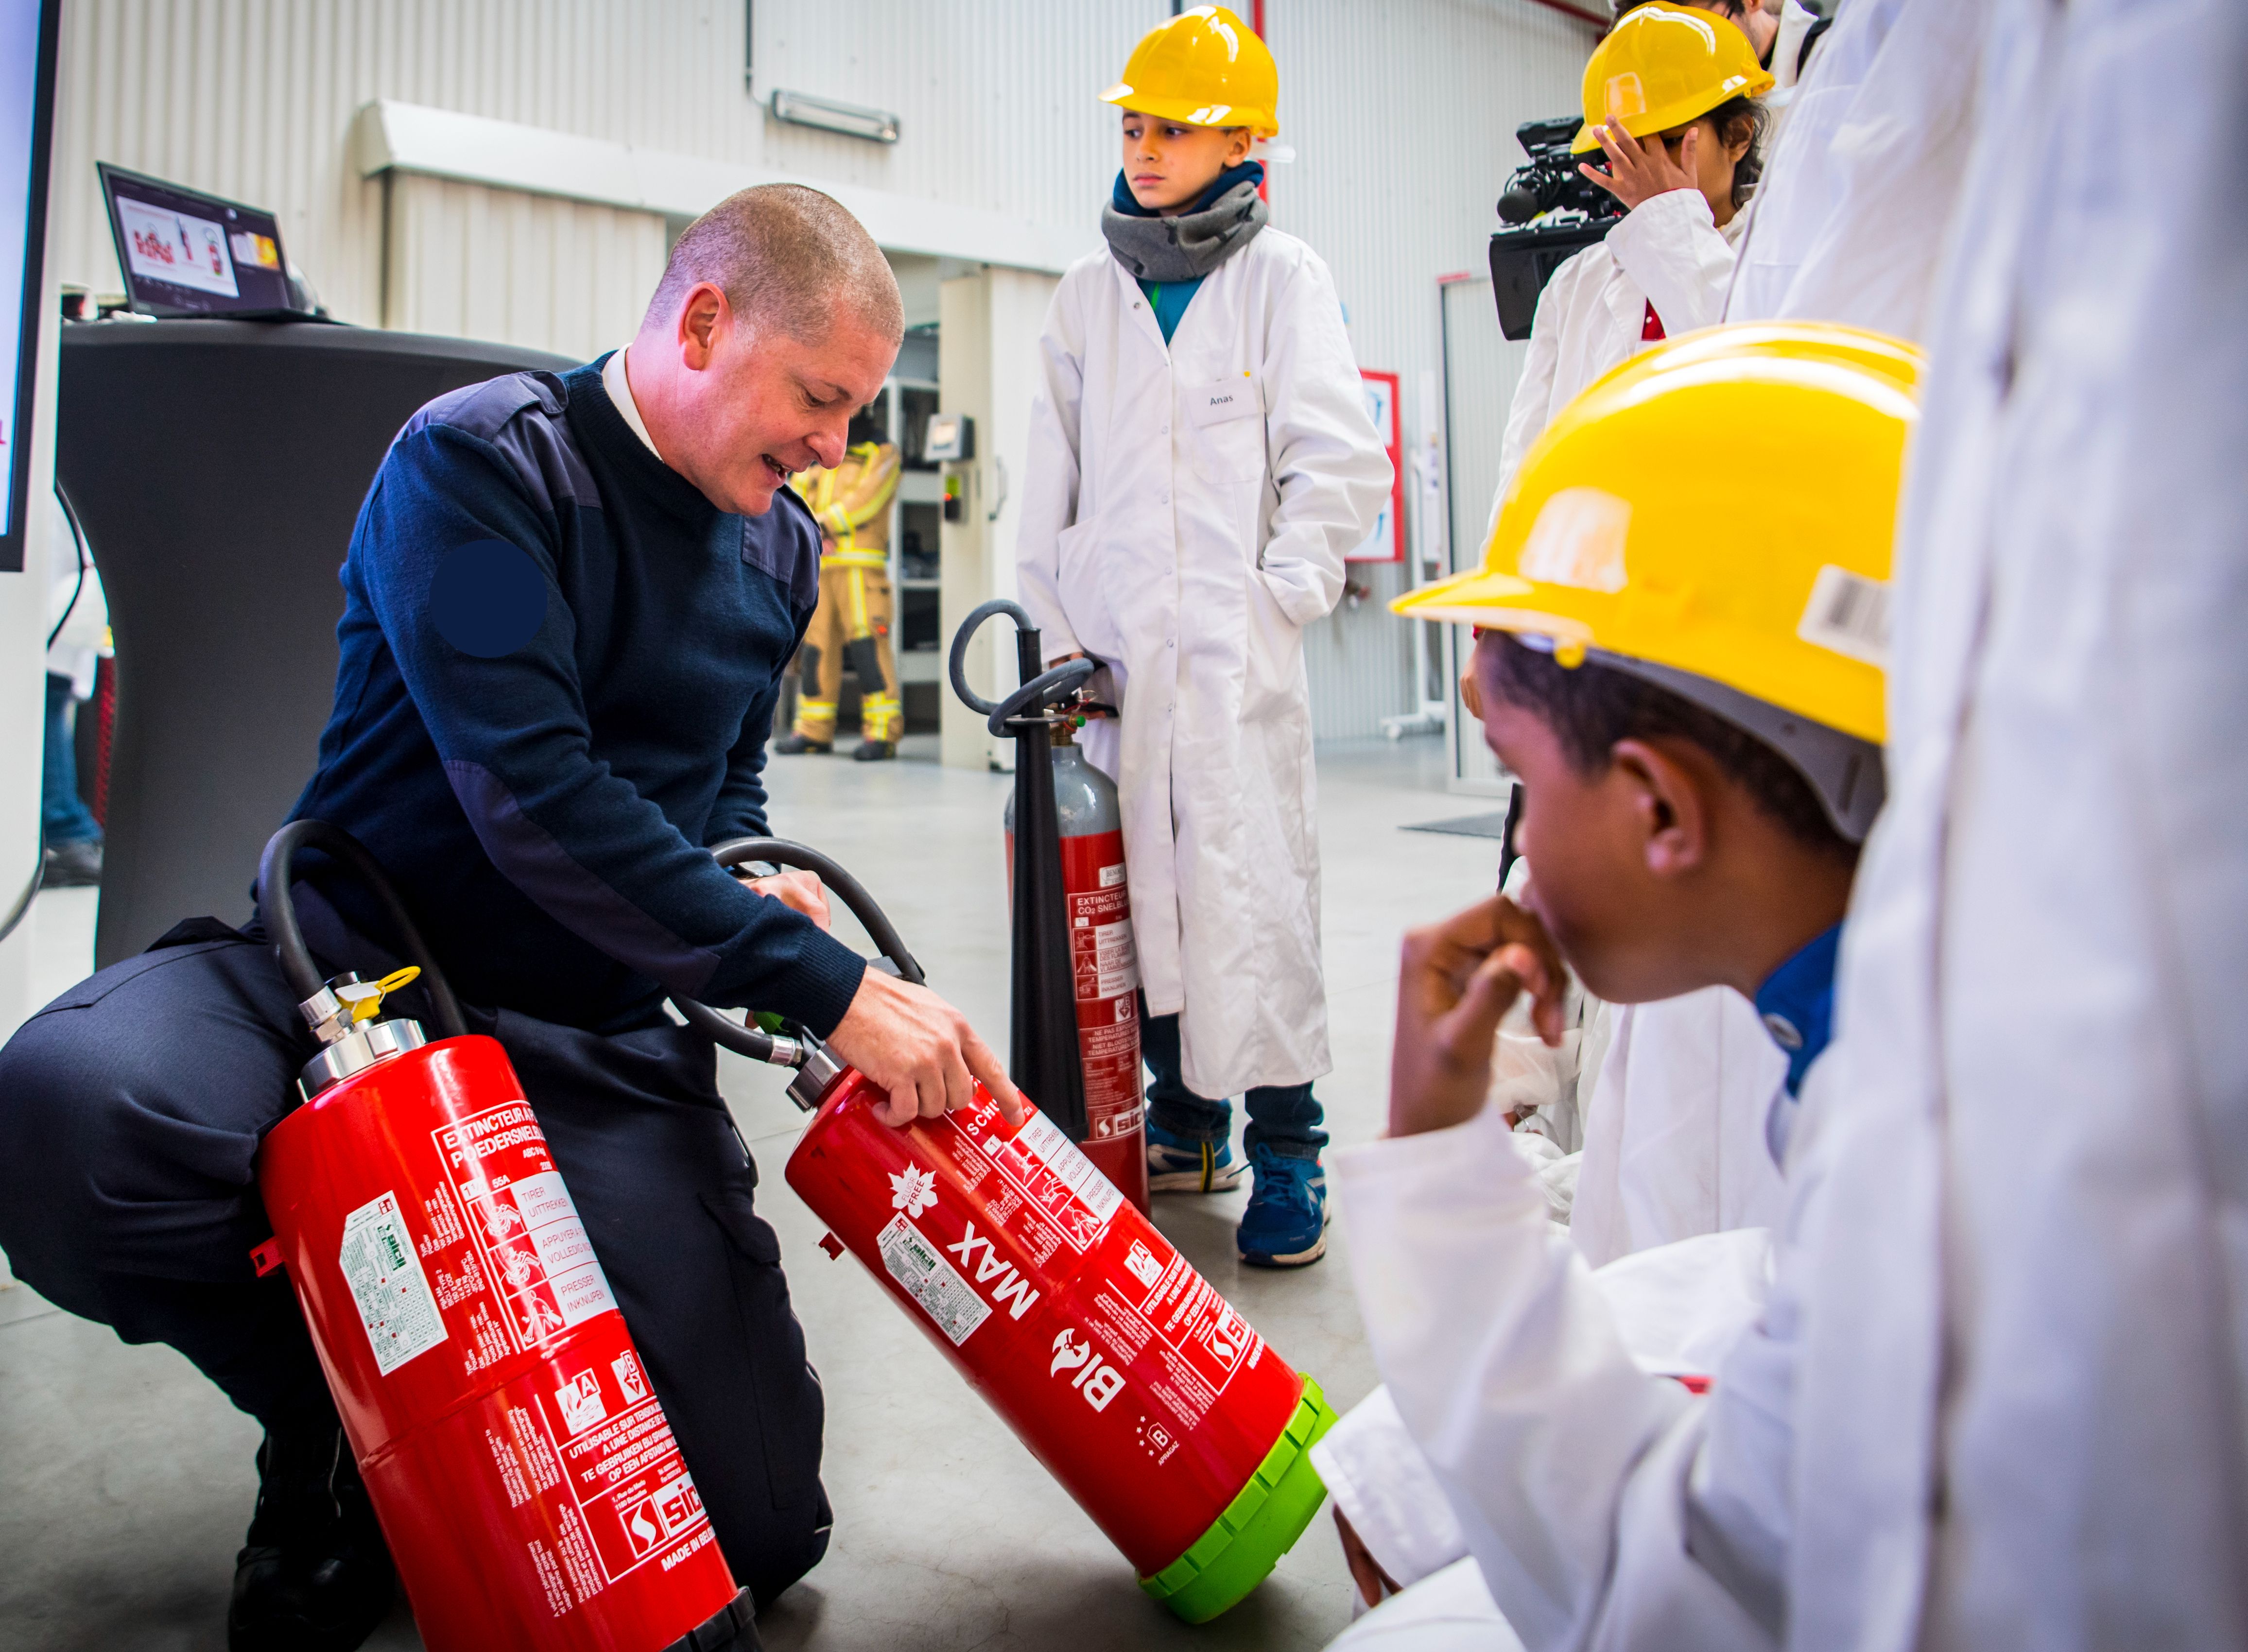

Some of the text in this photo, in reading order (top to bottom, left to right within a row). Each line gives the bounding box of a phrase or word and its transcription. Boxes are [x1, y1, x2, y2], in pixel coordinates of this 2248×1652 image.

[1210, 395, 1233, 406] Anas
[1077, 891, 1127, 906] EXTINCTEUR
[442, 1106, 525, 1150] EXTINCTEUR
[1028, 1126, 1043, 1142] TIRER
[1039, 1128, 1060, 1153] UITTREKKEN
[522, 1147, 538, 1158] ABC
[491, 1173, 511, 1189] 55A
[901, 1177, 917, 1202] FLUOR
[909, 1179, 925, 1205] FREE
[1086, 1179, 1104, 1201] PRESSER
[521, 1186, 545, 1202] TIRER
[434, 1187, 460, 1242] Temperatuurgrenzen
[438, 1180, 466, 1239] Goedkeuringsnummer
[528, 1195, 569, 1218] UITTREKKEN
[430, 1216, 444, 1238] gewicht
[431, 1198, 453, 1245] Vol gewicht min
[423, 1234, 434, 1254] Poeder
[432, 1239, 440, 1251] Gas
[438, 1238, 447, 1248] Vol
[541, 1227, 574, 1249] APPUYER
[419, 1243, 429, 1257] Type
[547, 1242, 583, 1264] VOLLEDIG
[1134, 1244, 1149, 1260] A
[445, 1272, 454, 1287] CO2
[947, 1221, 1039, 1320] MAX
[437, 1273, 448, 1291] TYPE
[458, 1287, 467, 1299] 14.4
[464, 1283, 472, 1296] 14.0
[561, 1274, 595, 1295] PRESSER
[1144, 1268, 1178, 1315] UTILISABLE SUR
[1169, 1284, 1182, 1300] UNE
[444, 1290, 454, 1306] SICLI
[452, 1291, 460, 1303] 150
[567, 1289, 605, 1312] INKNIJPEN
[1166, 1296, 1174, 1305] A
[1164, 1320, 1176, 1332] TE
[1171, 1289, 1196, 1324] GEBRUIKEN
[1183, 1313, 1193, 1326] OP
[1189, 1302, 1201, 1317] EEN
[469, 1314, 492, 1365] Poids plein max.
[478, 1301, 504, 1359] Températures limites
[482, 1330, 493, 1345] plein
[495, 1325, 511, 1356] Agrément
[385, 1335, 394, 1348] 2023
[467, 1349, 479, 1371] Poudre
[477, 1356, 486, 1369] Gaz
[488, 1345, 499, 1362] Poids
[622, 1352, 637, 1374] B
[1246, 1347, 1262, 1369] MADE
[464, 1360, 473, 1376] Type
[579, 1374, 597, 1397] A
[568, 1423, 620, 1459] UTILISABLE
[618, 1415, 636, 1430] SUR
[602, 1443, 611, 1456] A
[609, 1432, 629, 1450] UNE
[626, 1417, 657, 1440] DISTANCE
[1152, 1429, 1168, 1447] B
[520, 1446, 537, 1479] onderhoud
[580, 1468, 596, 1483] TE
[595, 1441, 644, 1475] GEBRUIKEN
[607, 1466, 623, 1483] OP
[622, 1457, 640, 1474] EEN
[639, 1442, 667, 1464] AFSTAND
[1158, 1440, 1180, 1466] APRAGAZ
[501, 1472, 520, 1507] Regelmatig
[661, 1537, 701, 1571] MADE IN
